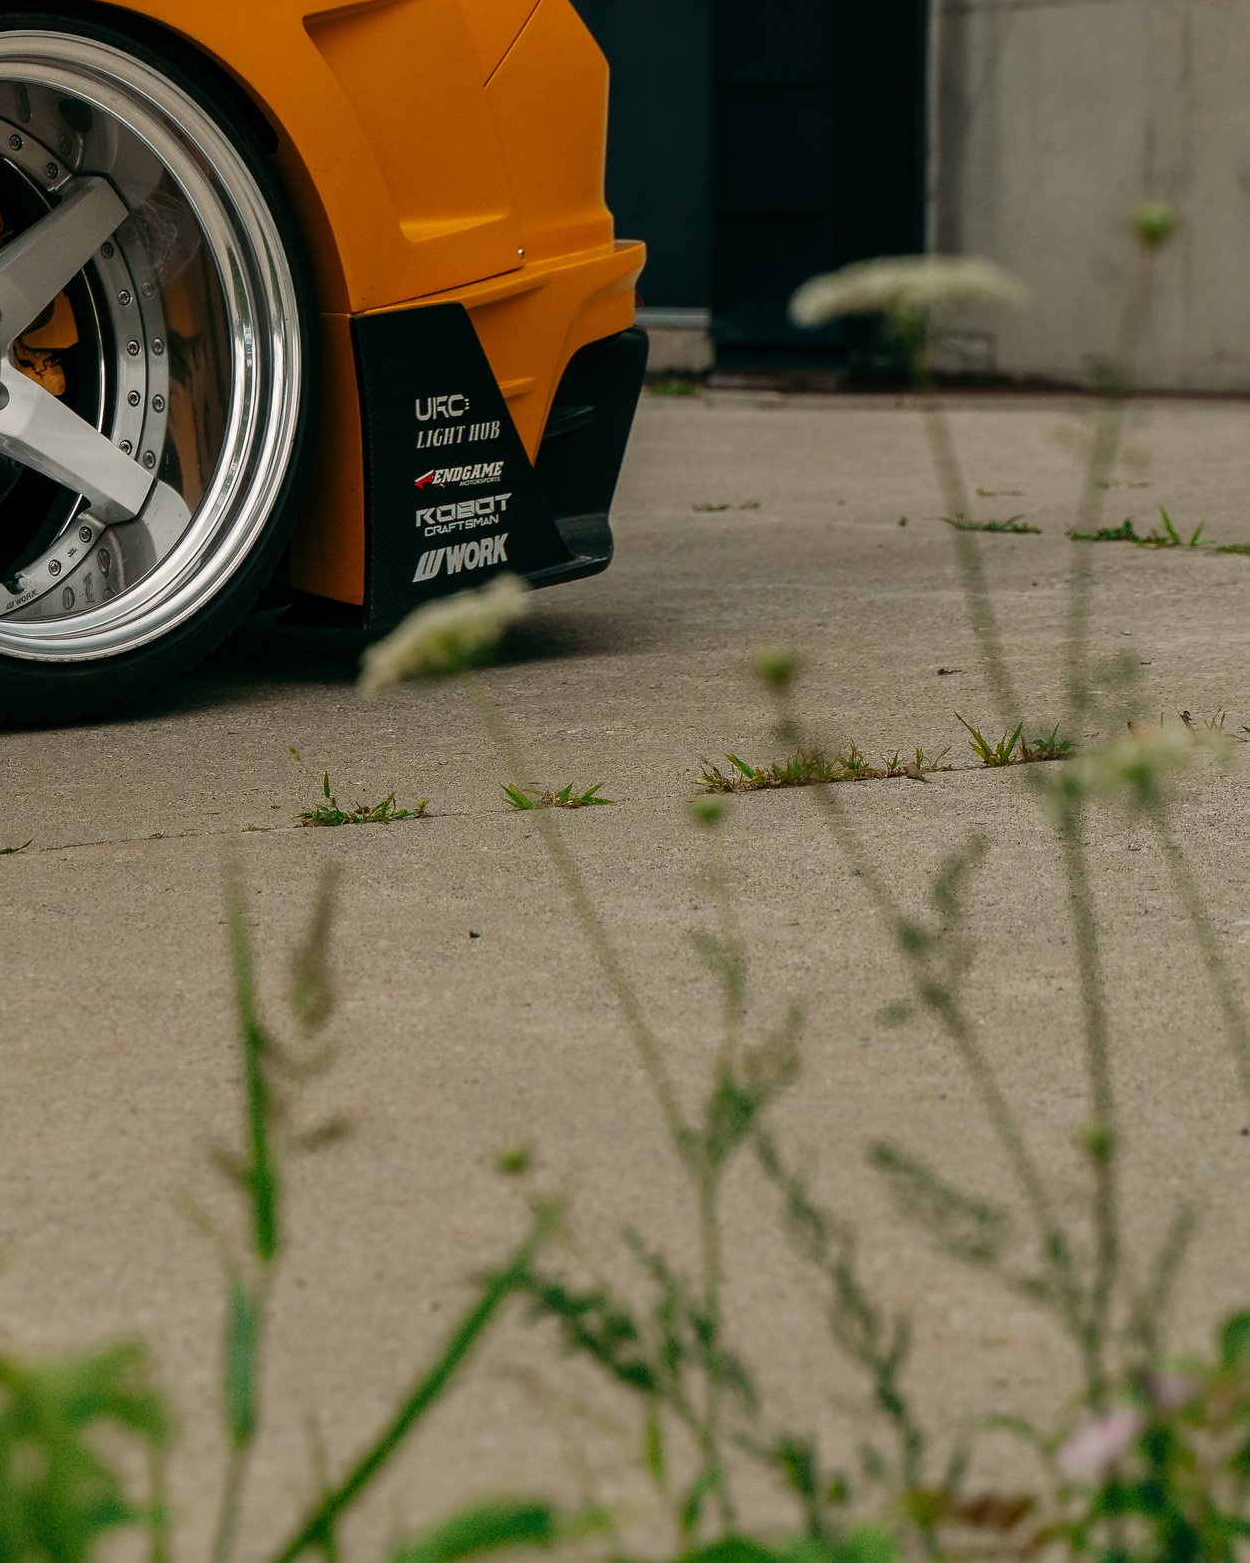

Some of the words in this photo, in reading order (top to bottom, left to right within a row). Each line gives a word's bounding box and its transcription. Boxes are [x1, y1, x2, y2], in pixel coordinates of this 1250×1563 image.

[416, 425, 466, 449] LIGHT
[468, 420, 500, 442] HUB
[432, 461, 505, 485] ENDGAME
[459, 476, 501, 487] MOTORSPORTS
[415, 493, 513, 527] ROBOT
[424, 514, 500, 537] CRAFTSMAN
[446, 533, 510, 575] WORK
